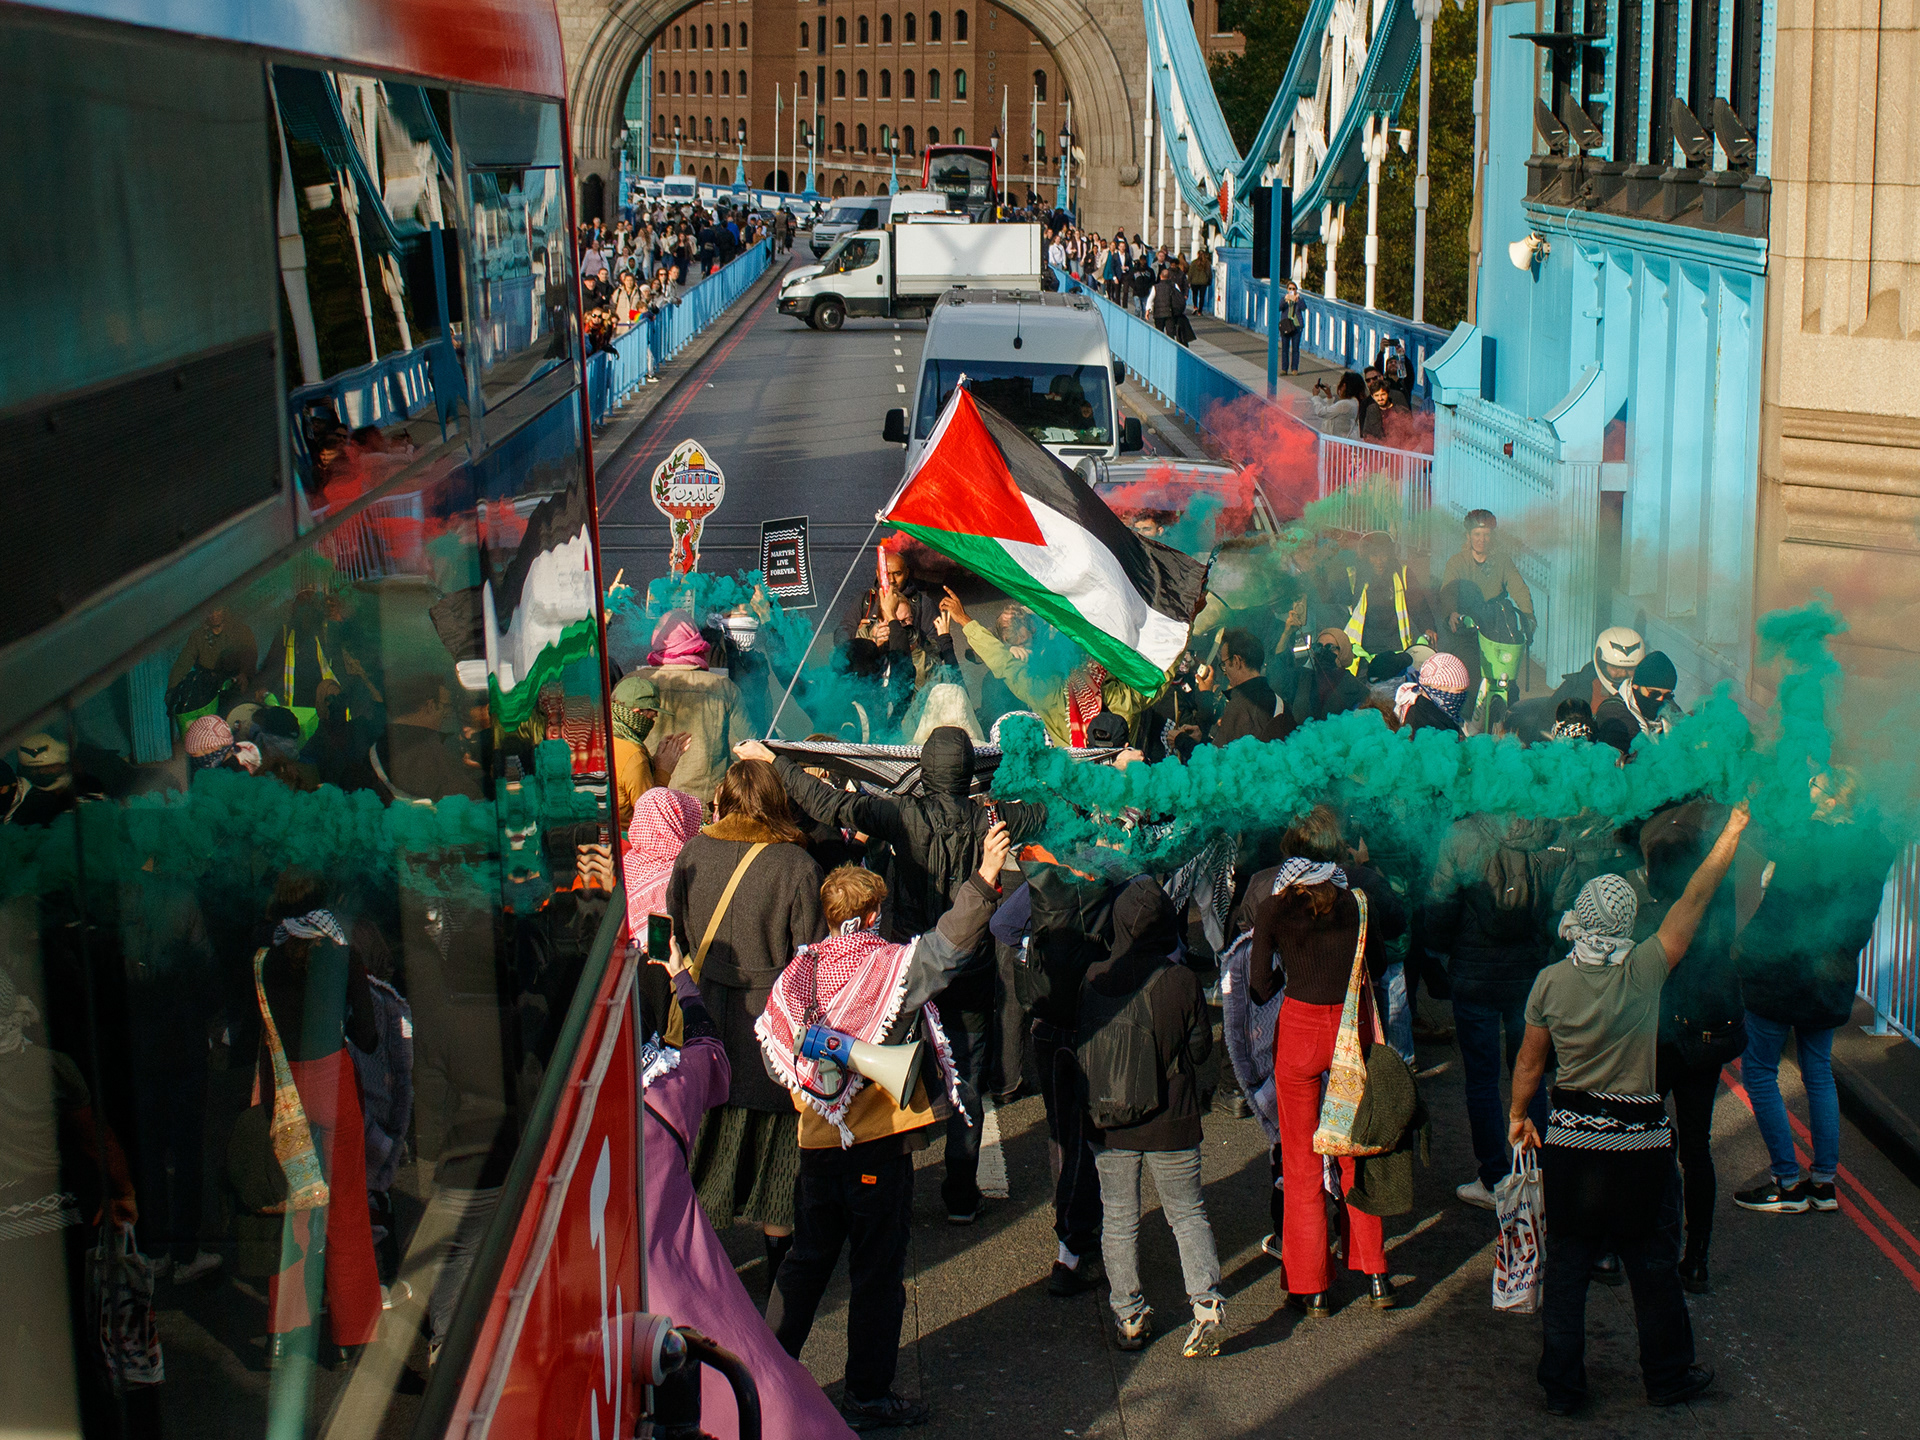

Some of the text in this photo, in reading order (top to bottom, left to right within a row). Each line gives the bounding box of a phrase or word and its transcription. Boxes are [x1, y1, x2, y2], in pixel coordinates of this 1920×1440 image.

[988, 50, 996, 104] DOCKS
[972, 185, 985, 196] 343
[673, 484, 716, 502] عائدون
[771, 549, 796, 558] MARTYRS
[776, 558, 789, 566] LIVE
[770, 567, 797, 577] FOREVER.
[1500, 1206, 1518, 1224] Mad
